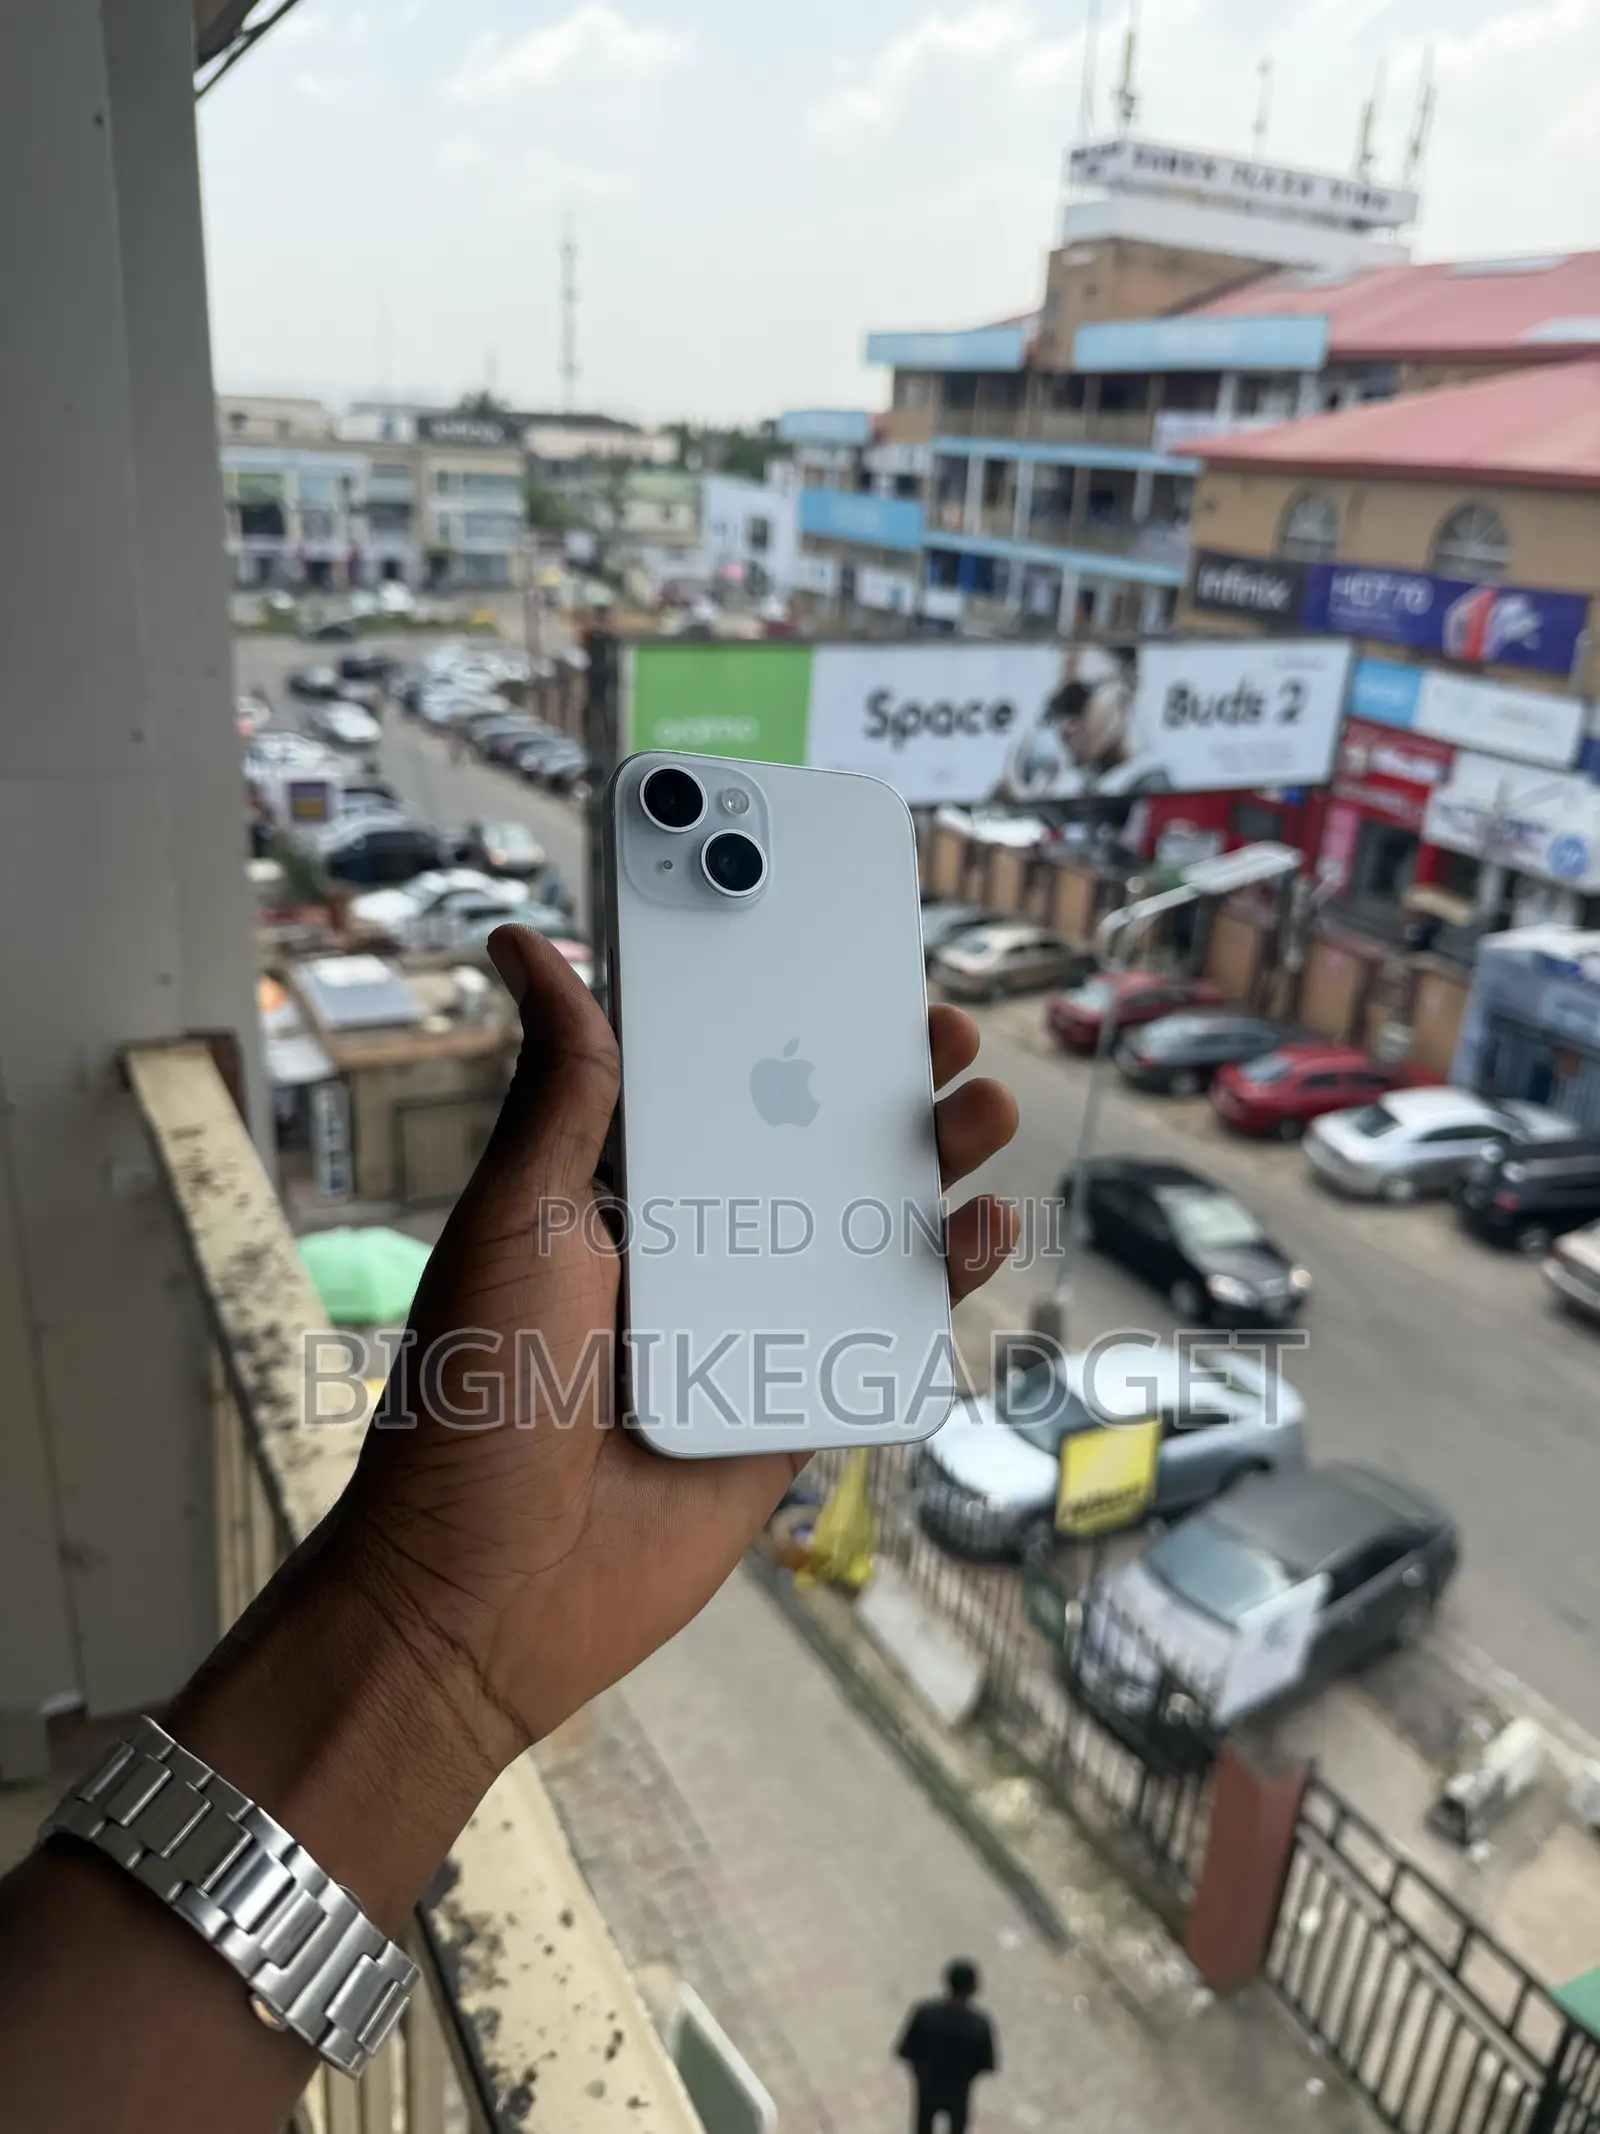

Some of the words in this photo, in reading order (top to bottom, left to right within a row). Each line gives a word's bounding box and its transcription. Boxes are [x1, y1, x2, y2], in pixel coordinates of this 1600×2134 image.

[861, 686, 1018, 752] Space
[1162, 673, 1265, 729] Buds
[1276, 678, 1309, 728] 2
